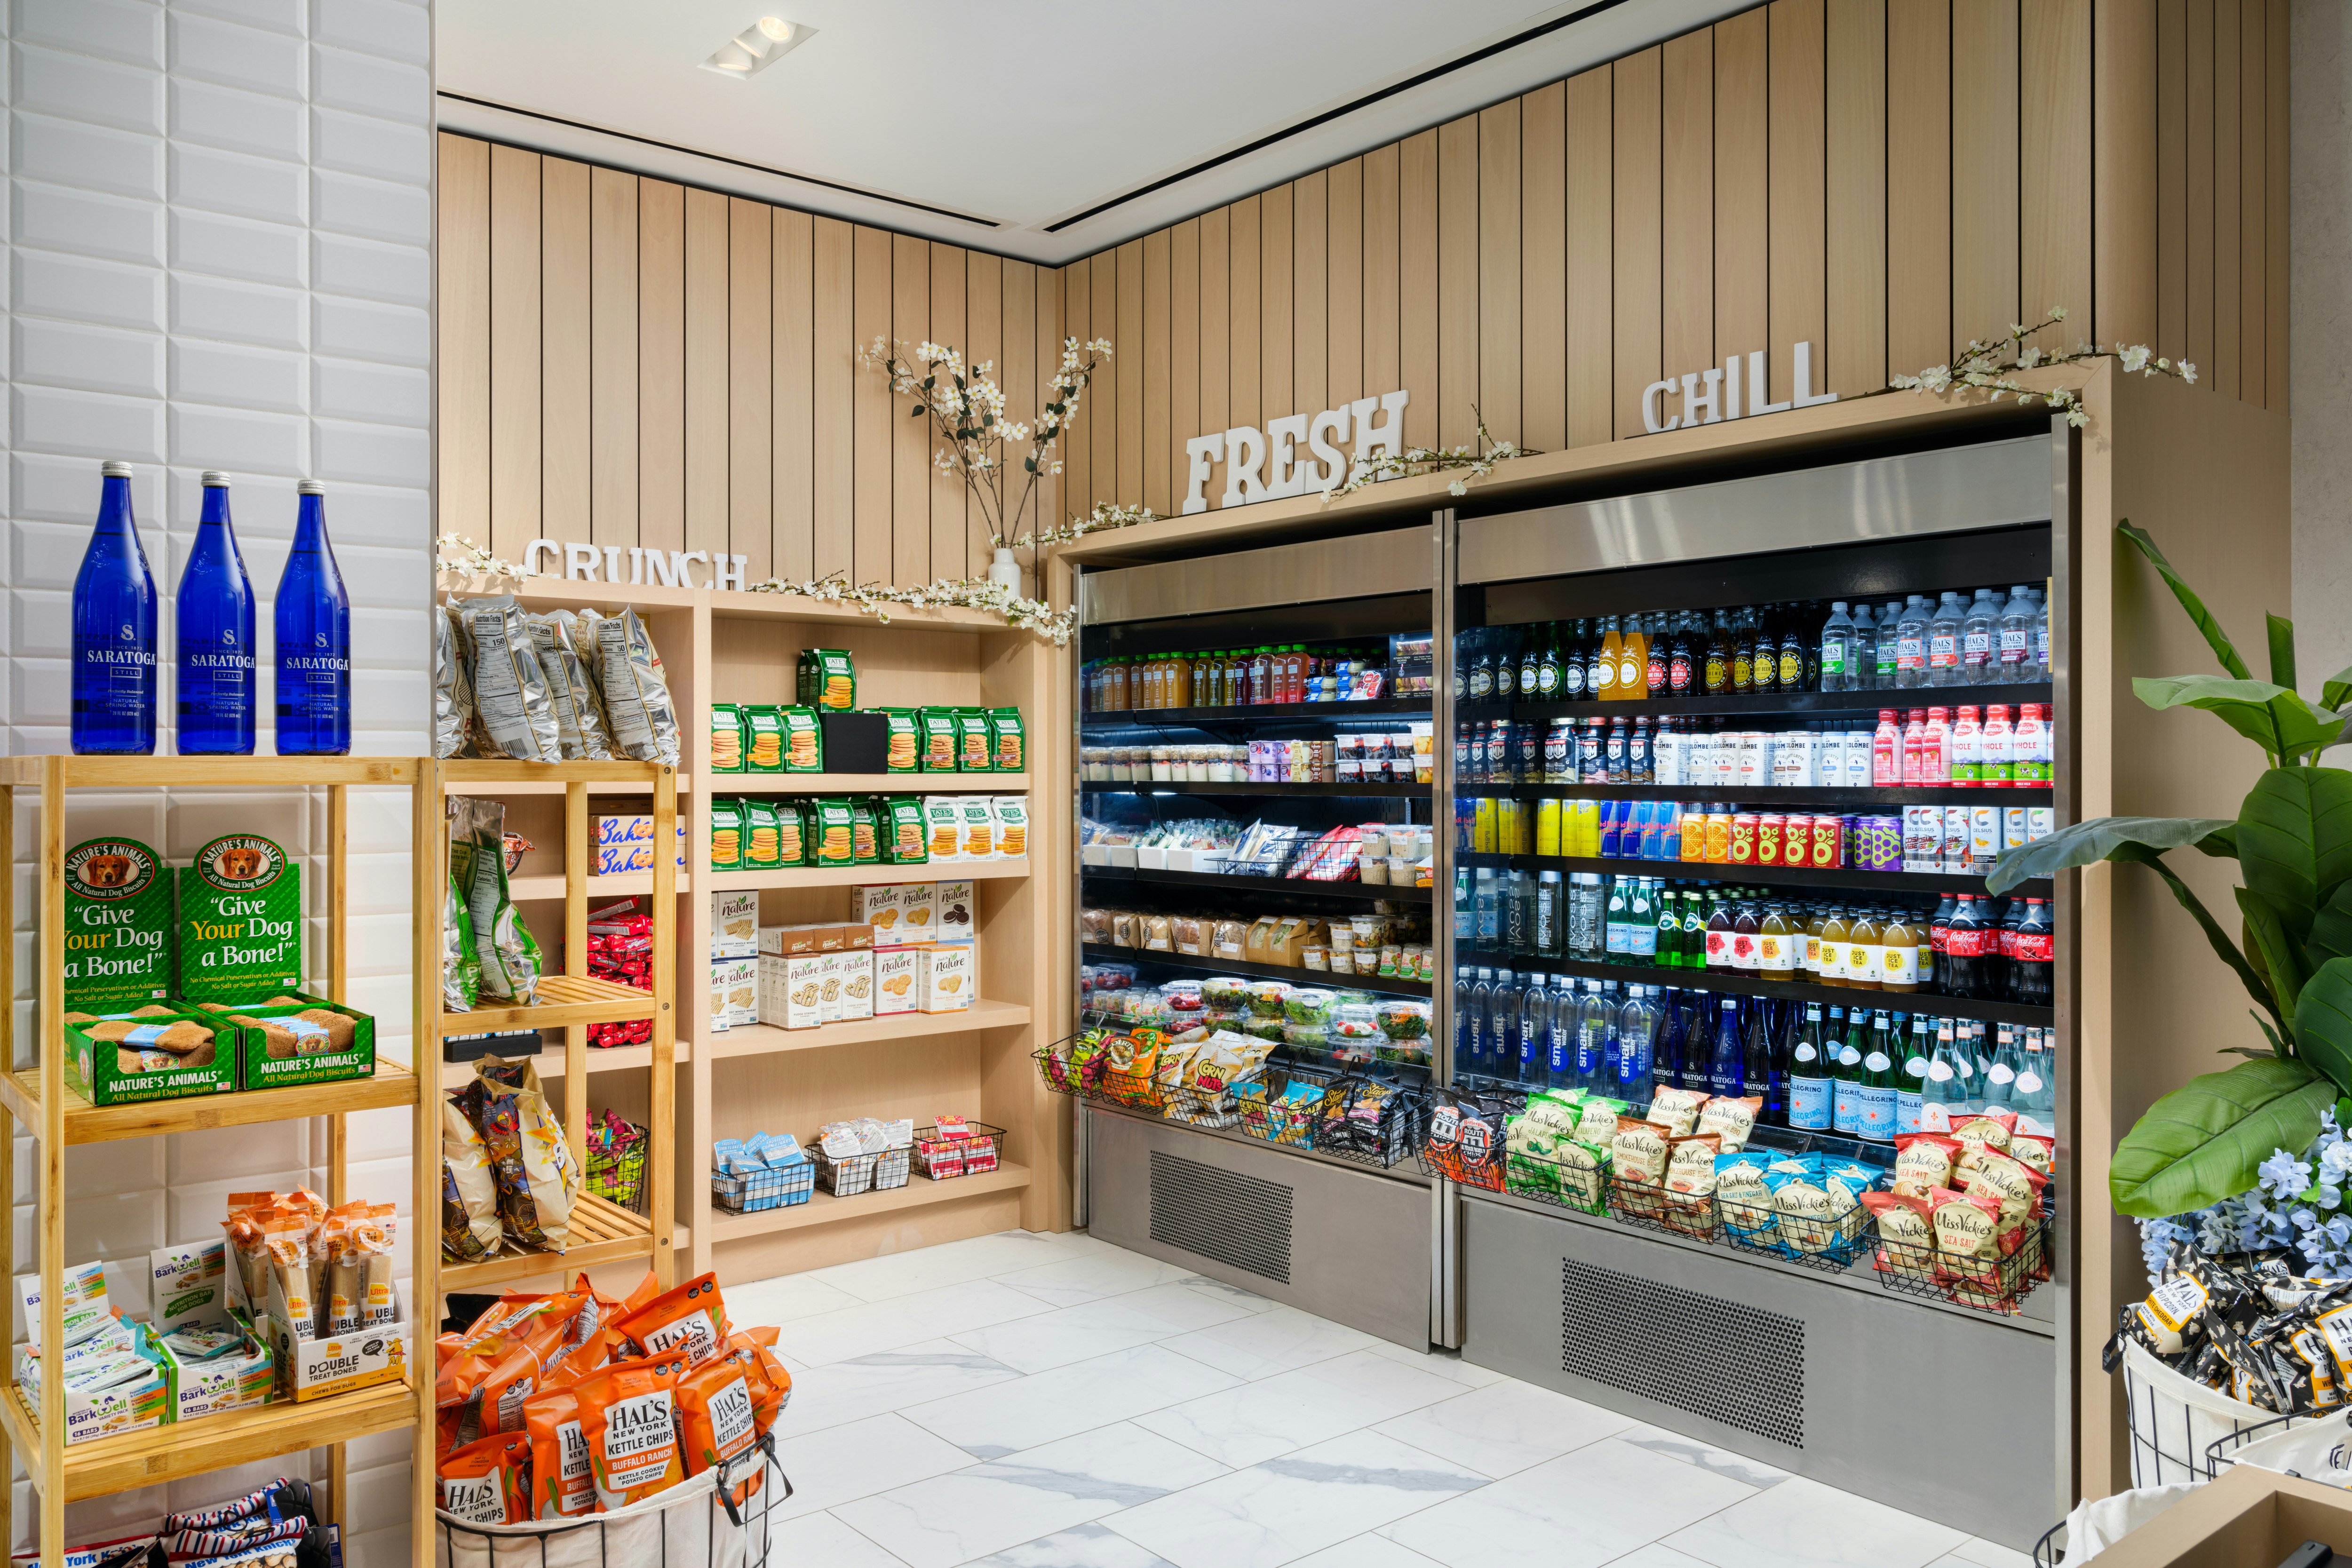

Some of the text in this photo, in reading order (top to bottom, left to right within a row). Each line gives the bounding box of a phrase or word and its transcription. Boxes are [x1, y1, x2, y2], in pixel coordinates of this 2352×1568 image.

[1642, 341, 1840, 433] CHILL
[1183, 390, 1409, 515] FRESH
[524, 539, 747, 592] CRUNCH
[493, 638, 505, 646] 150
[88, 650, 156, 665] SARATOGA
[286, 658, 348, 670] SARATOGA
[202, 839, 278, 864] NATURE'S ANIMALS
[208, 874, 217, 882] All
[218, 879, 240, 888] Natural
[255, 871, 276, 885] Biscuits
[723, 901, 755, 915] nature
[190, 918, 293, 941] Your Dog
[2017, 936, 2047, 947] Coca-Cola
[201, 952, 217, 967] a
[882, 956, 912, 973] nature
[791, 964, 820, 979] nature
[261, 1054, 359, 1074] NATURE'S ANIMALS
[1198, 1059, 1225, 1080] CORN
[263, 1067, 356, 1083] All Natural Dog Biscuits
[1362, 1082, 1393, 1098] Stacy's
[1464, 1120, 1486, 1128] Barbeque
[1464, 1129, 1484, 1137] ROUTE
[1465, 1137, 1480, 1146] 11
[1615, 1135, 1663, 1157] Miss Vickie's
[1617, 1152, 1657, 1167] SMOKEHOUSE BBQ
[1934, 1212, 1993, 1239] Miss Vickie's
[1945, 1235, 1976, 1249] SEA SALT
[169, 1295, 198, 1312] NUTRITION
[189, 1298, 204, 1307] DOGS
[2155, 1289, 2179, 1315] POPCORN
[2165, 1284, 2189, 1310] NEW YORK
[2145, 1315, 2154, 1327] CHEESE
[2154, 1306, 2172, 1326] CHEDDAR
[310, 1354, 359, 1375] DOUBLE
[310, 1367, 357, 1382] TREAT BONES
[715, 1386, 747, 1421] HAL'S
[612, 1400, 667, 1432] HAL'S
[721, 1406, 748, 1429] NEW YORK
[613, 1421, 667, 1439] NEW YORK
[717, 1424, 740, 1445] KETTLE
[608, 1429, 673, 1455] KETTLE CHIPS
[720, 1439, 742, 1458] BUFFALO
[612, 1448, 672, 1471] BUFFALO RANCH
[618, 1465, 664, 1480] KETTLE COOKED
[622, 1471, 662, 1485] POTATO CHIPS
[66, 1553, 96, 1567] York
[222, 1550, 252, 1561] York
